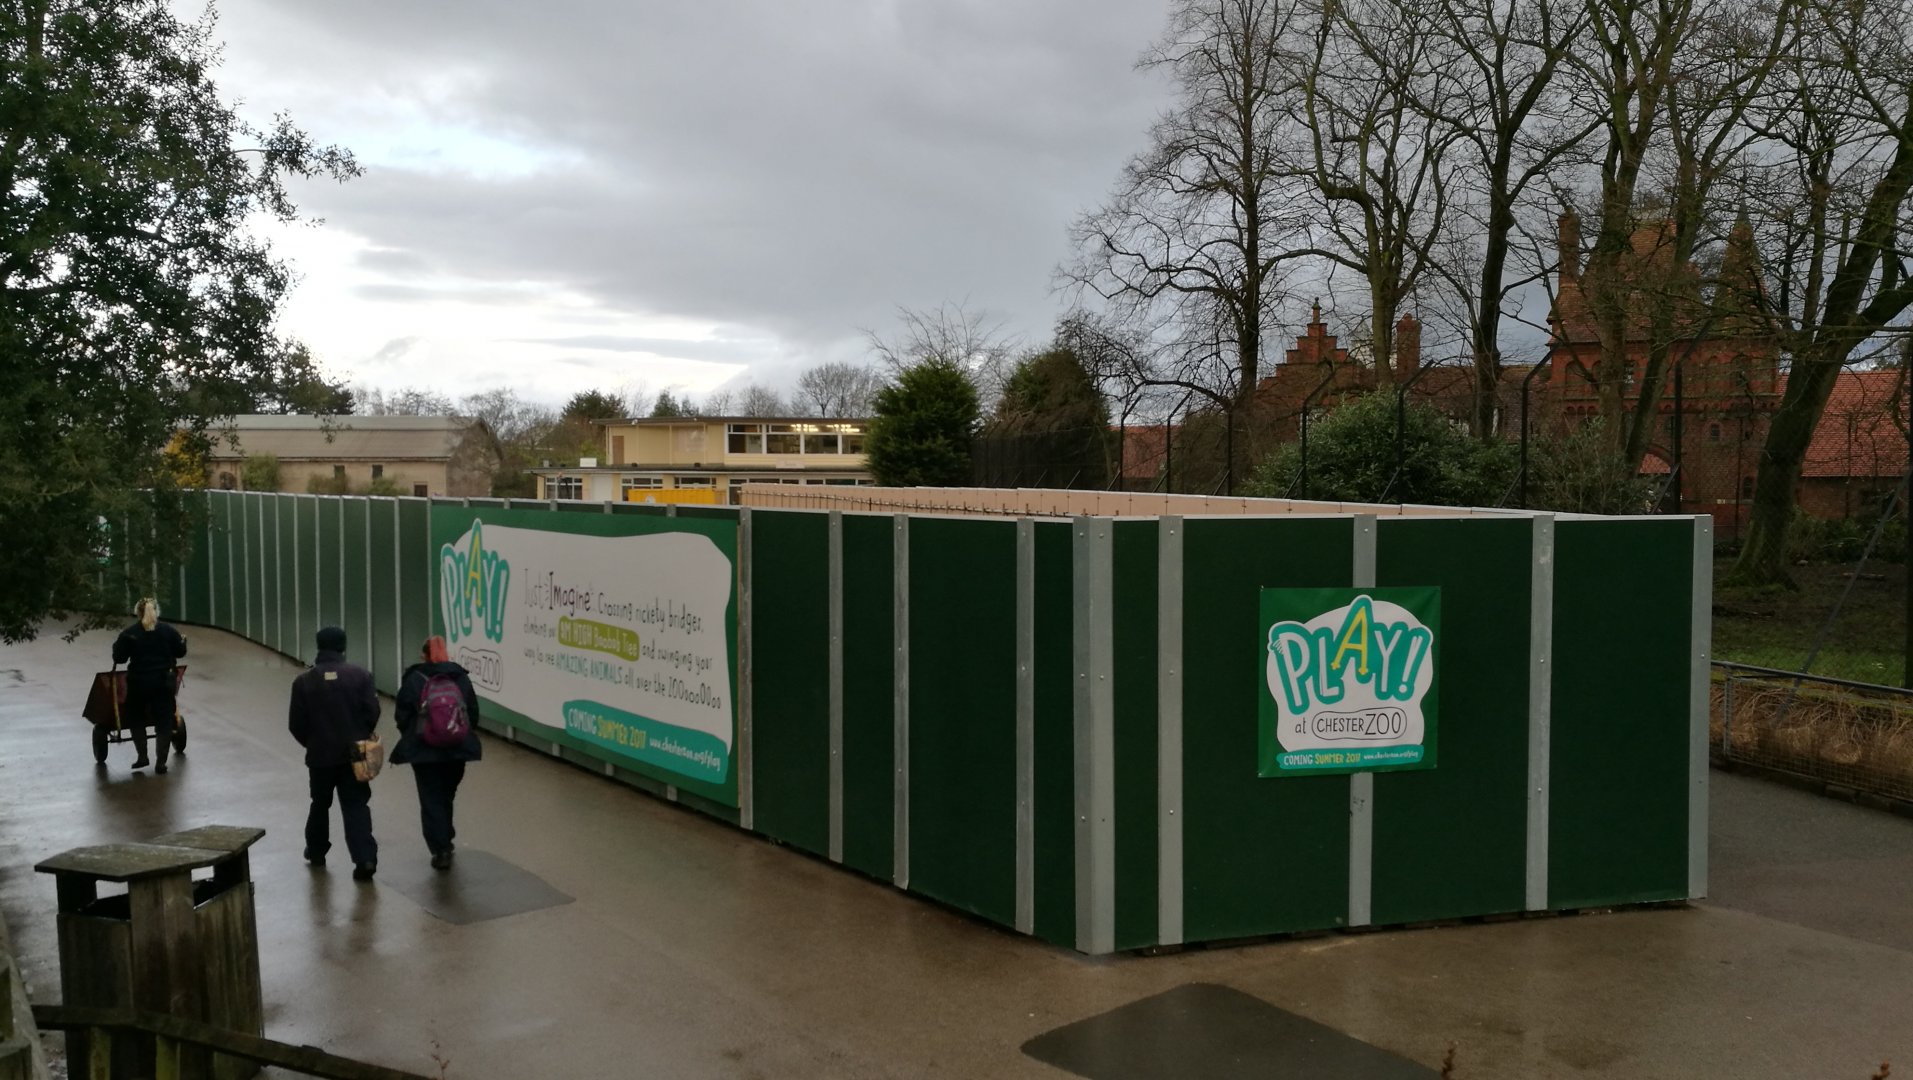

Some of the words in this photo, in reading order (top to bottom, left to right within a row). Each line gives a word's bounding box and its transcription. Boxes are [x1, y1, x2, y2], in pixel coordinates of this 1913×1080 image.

[443, 522, 509, 640] PLAY!
[598, 592, 633, 621] Crossing
[636, 596, 665, 633] rickety
[574, 622, 592, 646] HIGH
[623, 632, 637, 658] Tree
[642, 638, 655, 660] and
[658, 648, 692, 672] swinging
[696, 655, 713, 677] your
[1271, 600, 1428, 712] PLAY!
[482, 656, 500, 686] ZOO
[556, 653, 588, 678] AMAZING
[590, 658, 622, 685] ANIMALS
[625, 667, 635, 689] all
[637, 677, 651, 693] over
[654, 672, 665, 697] the
[568, 708, 597, 735] COMING
[597, 715, 628, 746] SUMMER
[629, 725, 647, 750] 2017
[1295, 717, 1307, 734] at
[1317, 717, 1364, 733] CHESTER
[1365, 711, 1402, 735] ZOO
[1284, 754, 1313, 765] COMING
[1315, 752, 1344, 764] SUMMER
